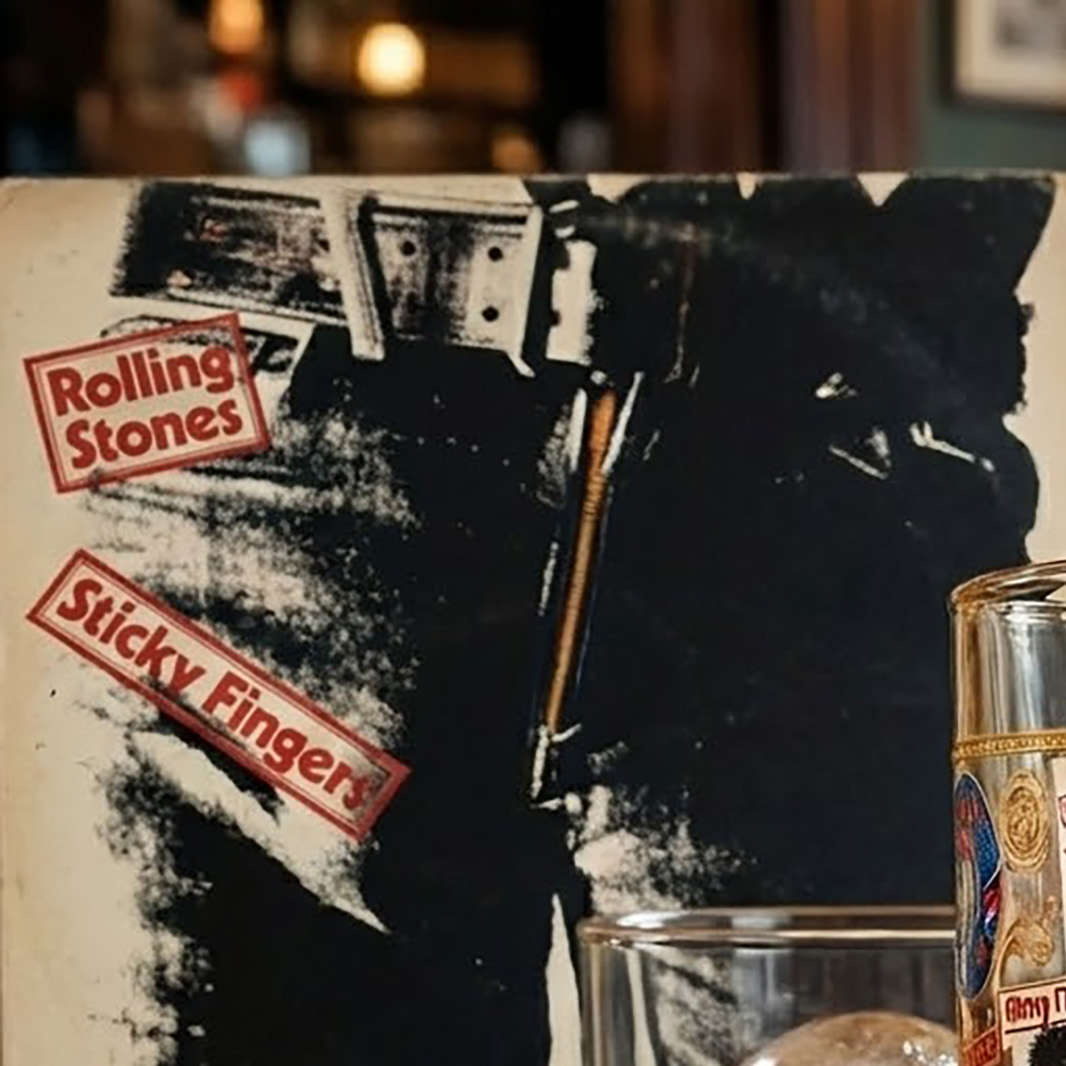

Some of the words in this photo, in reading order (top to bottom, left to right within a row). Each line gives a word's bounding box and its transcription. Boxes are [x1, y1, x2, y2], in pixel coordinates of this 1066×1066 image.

[46, 345, 234, 417] Rolling
[64, 399, 244, 470] Stones
[57, 577, 207, 692] Sticky
[199, 673, 374, 811] Fingers
